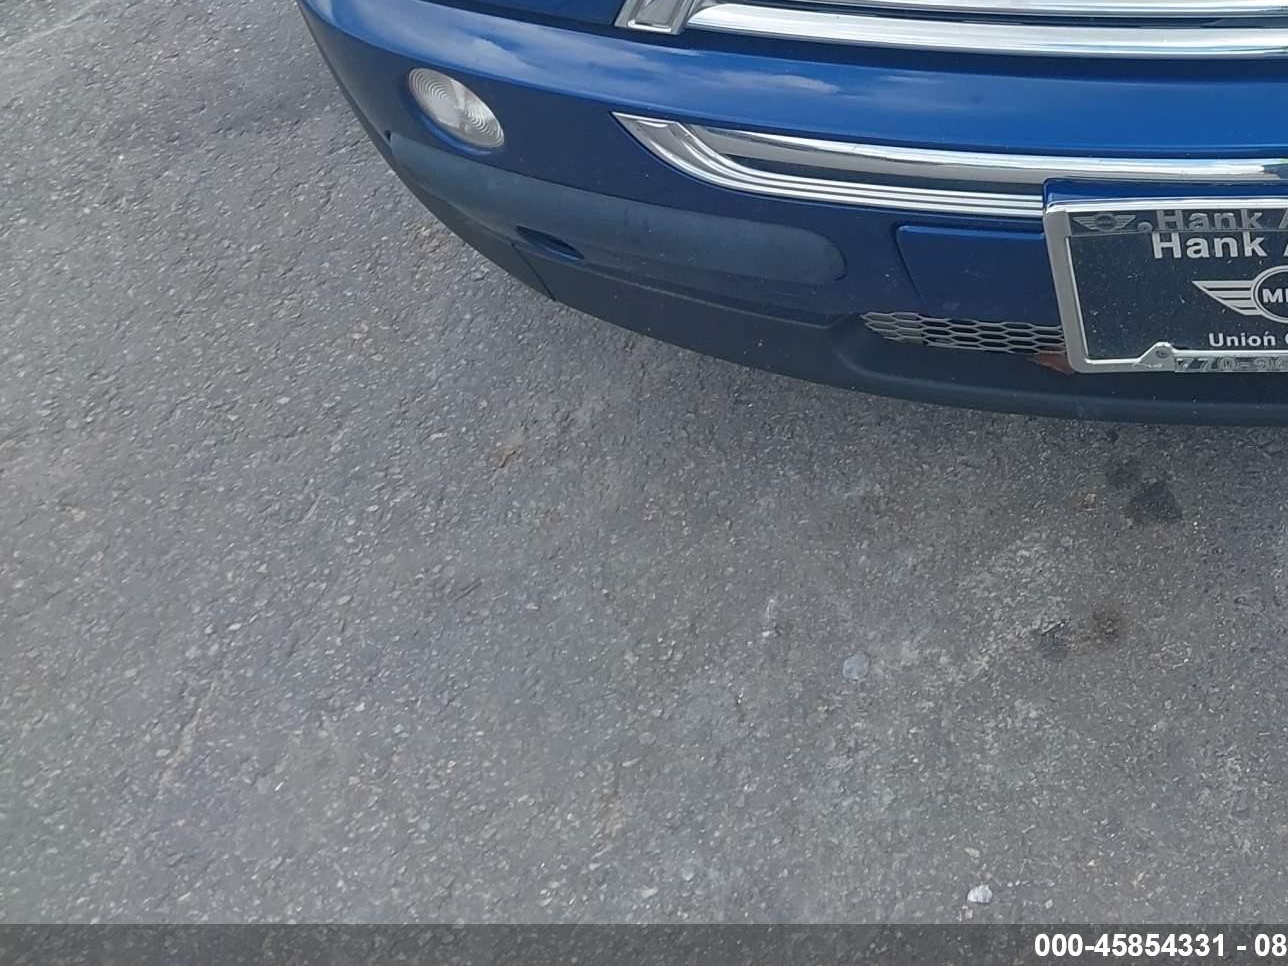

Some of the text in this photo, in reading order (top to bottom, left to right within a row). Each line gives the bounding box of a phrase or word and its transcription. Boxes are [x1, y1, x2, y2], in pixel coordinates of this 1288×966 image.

[1155, 209, 1263, 230] Hank
[1151, 231, 1268, 258] Hank
[1208, 331, 1276, 347] Union
